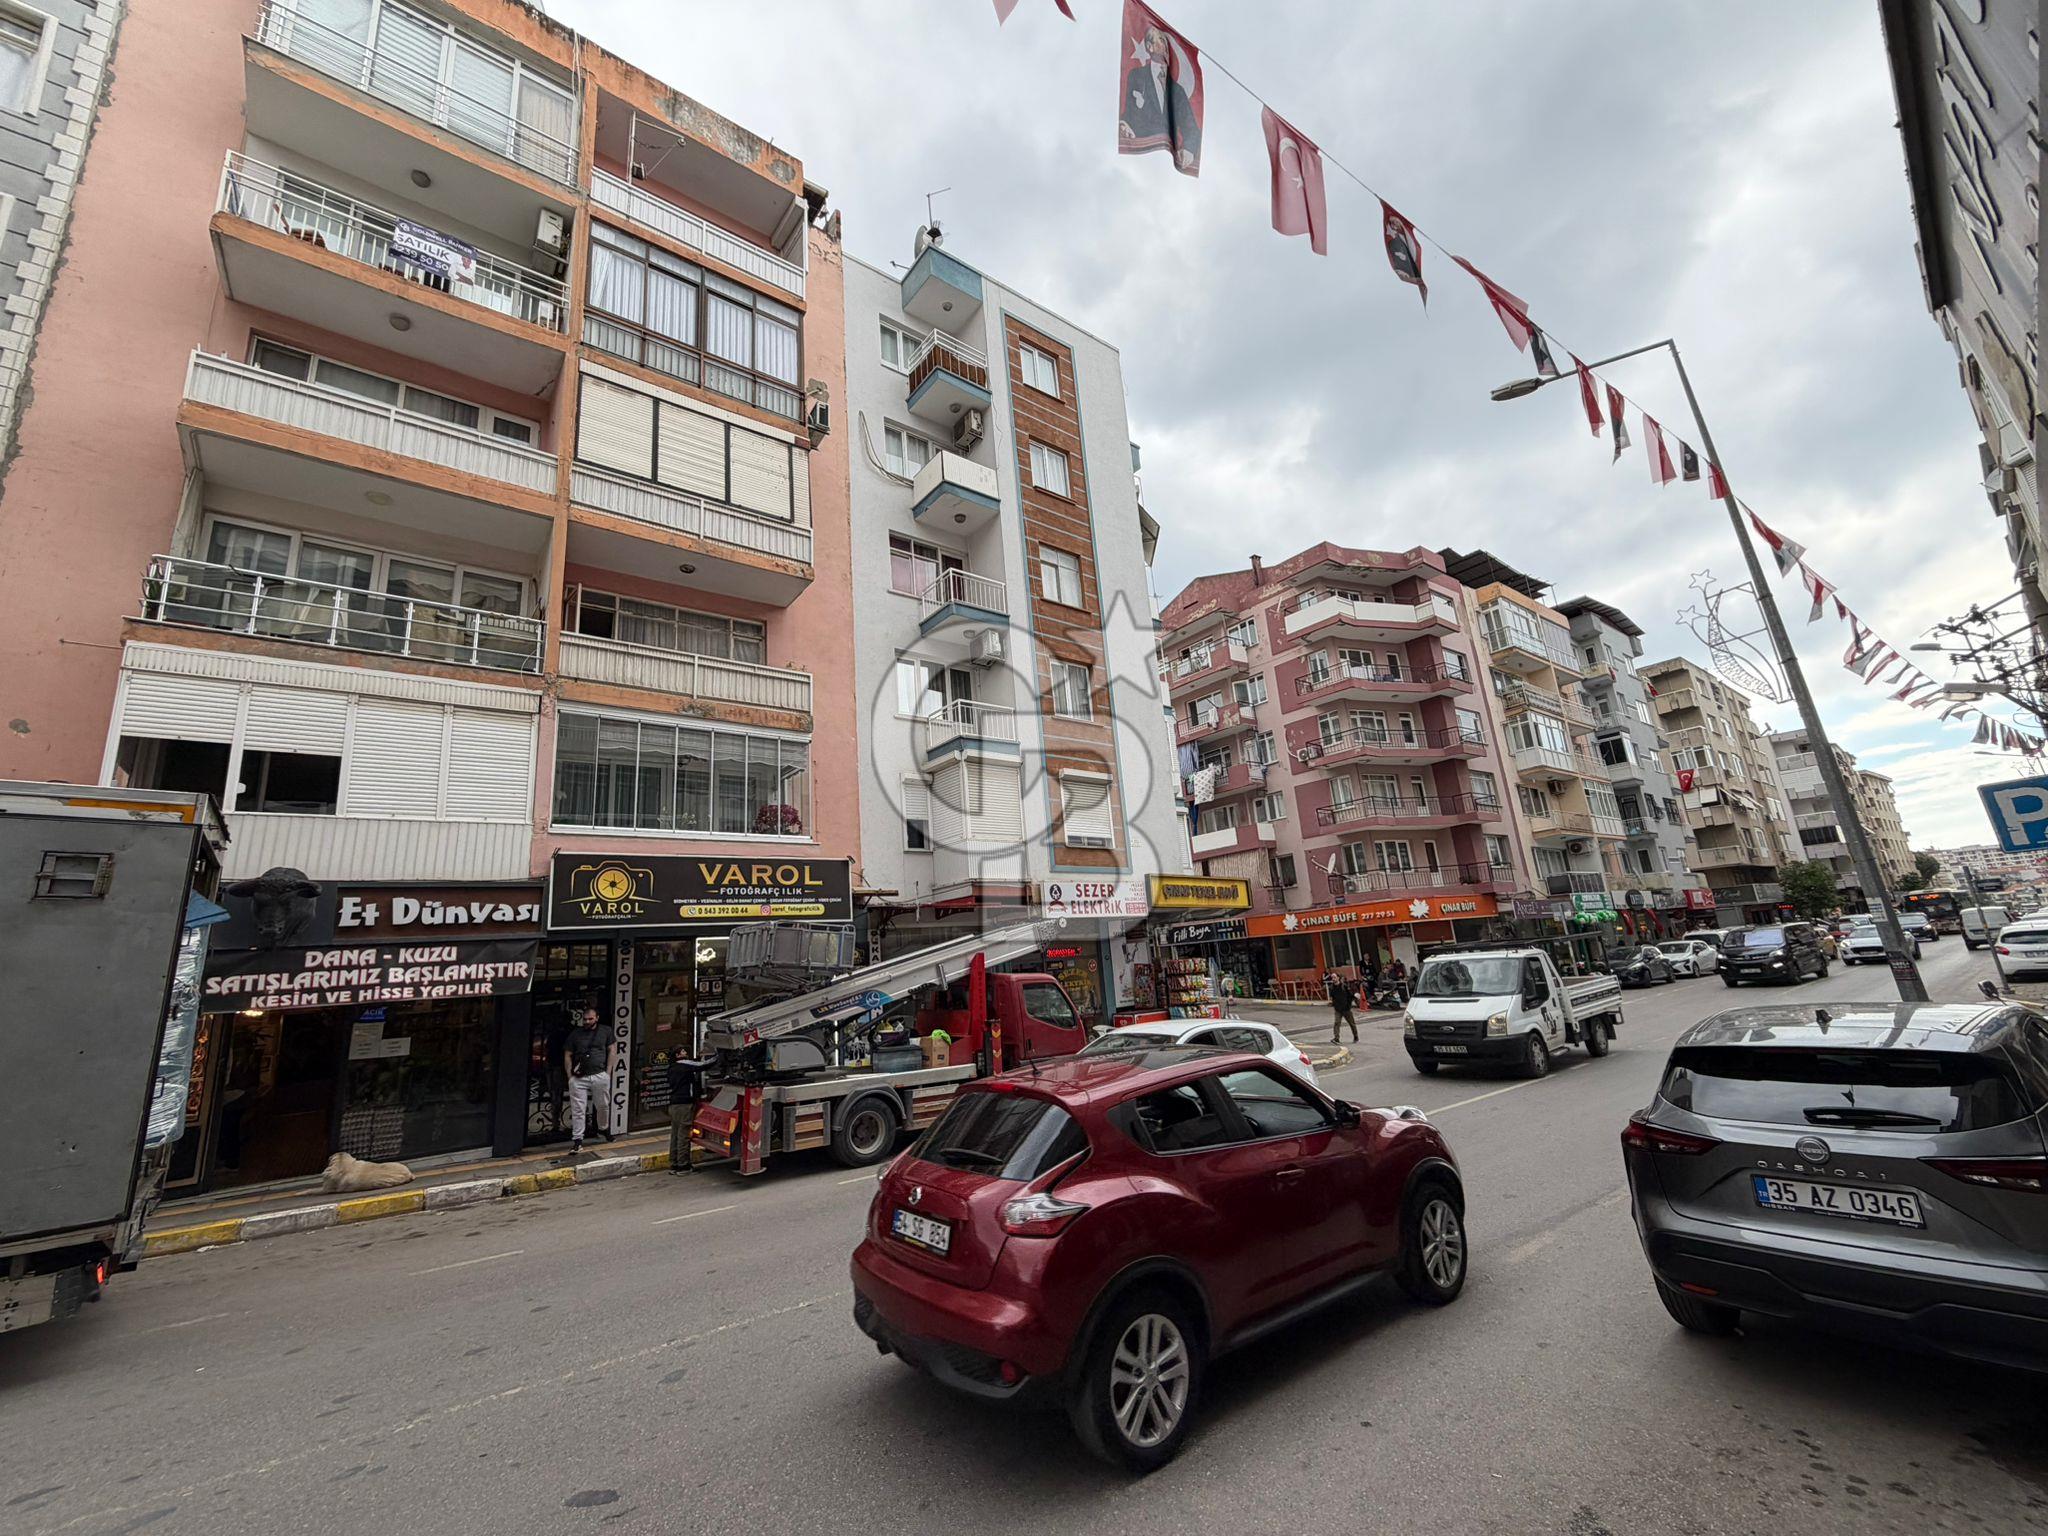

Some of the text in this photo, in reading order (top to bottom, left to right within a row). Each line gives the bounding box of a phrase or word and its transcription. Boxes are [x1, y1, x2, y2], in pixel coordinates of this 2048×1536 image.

[396, 233, 450, 261] SATILIK
[412, 227, 449, 244] COLDWELL
[449, 240, 472, 254] BANKER
[420, 256, 433, 266] 50
[435, 262, 449, 271] 50
[1993, 786, 2048, 846] P
[698, 863, 823, 886] VAROL
[1075, 883, 1116, 898] SEZER
[338, 897, 540, 927] Et Dünyası
[581, 902, 643, 914] VAROL
[1070, 900, 1123, 914] ELEKTRİK
[1441, 900, 1477, 914] ÇINAR BÜFE
[1301, 915, 1331, 928] ÇINAR
[1333, 911, 1358, 924] BÜFE
[1361, 912, 1375, 920] 277
[1173, 925, 1211, 943] Filli Boya
[304, 949, 377, 969] DANA
[399, 946, 458, 963] KUZU
[206, 961, 529, 995] SATIŞLARIMIZ BAŞLAMIŞTIR
[251, 982, 494, 1009] KESİM VE HİSSE YAPILIR
[612, 957, 630, 1128] FOTOĞRAFÇI
[1757, 1160, 1888, 1180] QASHQAI
[1758, 1190, 1768, 1198] TR
[1768, 1182, 1798, 1203] 35
[1811, 1186, 1839, 1209] AZ
[1849, 1191, 1914, 1219] 0346
[1761, 1202, 1796, 1212] NISSAN
